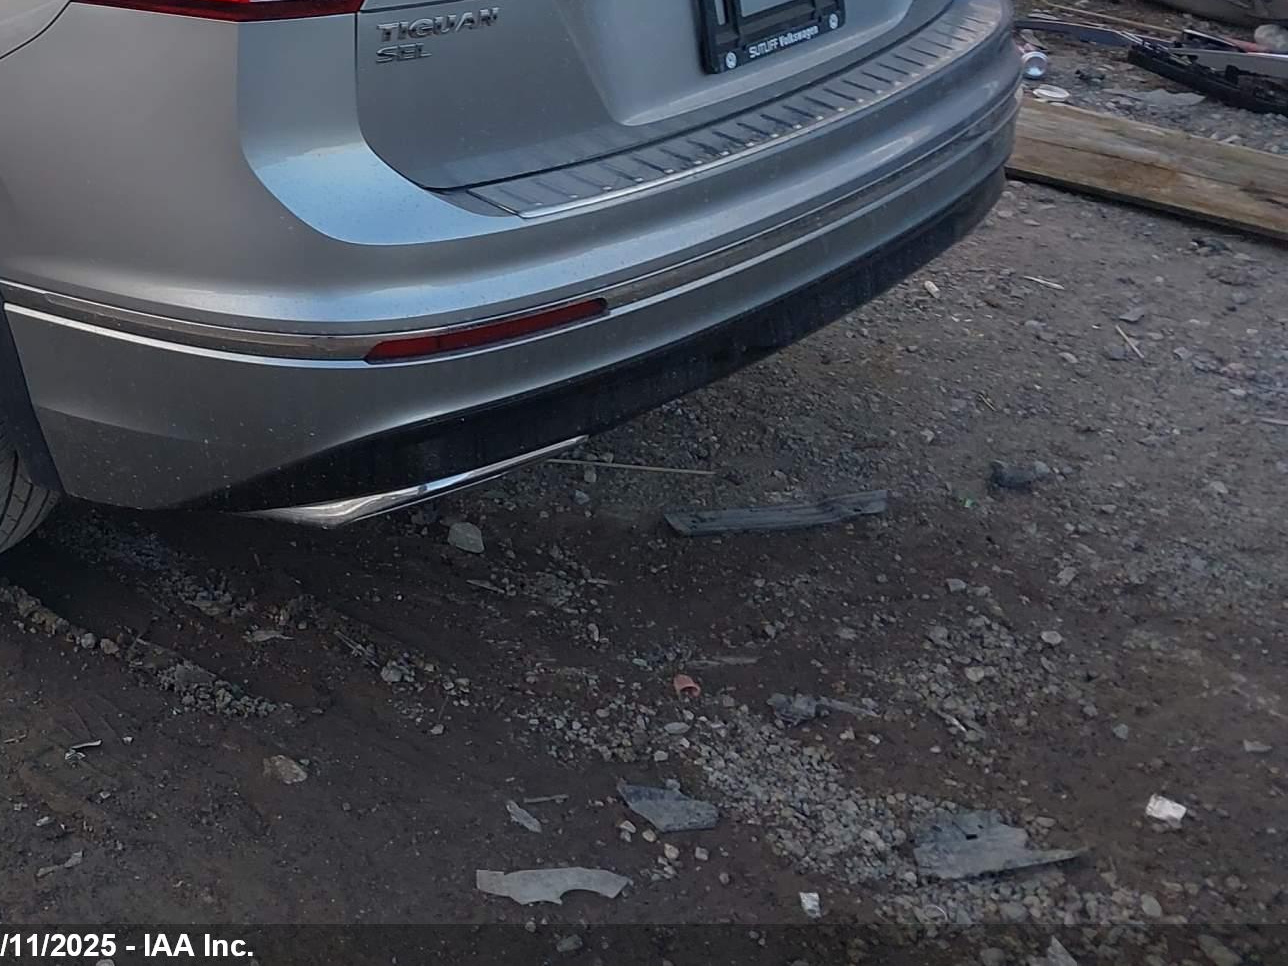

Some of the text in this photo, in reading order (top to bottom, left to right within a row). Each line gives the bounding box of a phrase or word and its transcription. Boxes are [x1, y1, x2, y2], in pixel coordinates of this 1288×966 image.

[376, 7, 500, 42] TIGUAN
[778, 25, 820, 47] Volkswagen
[376, 42, 432, 64] SEL
